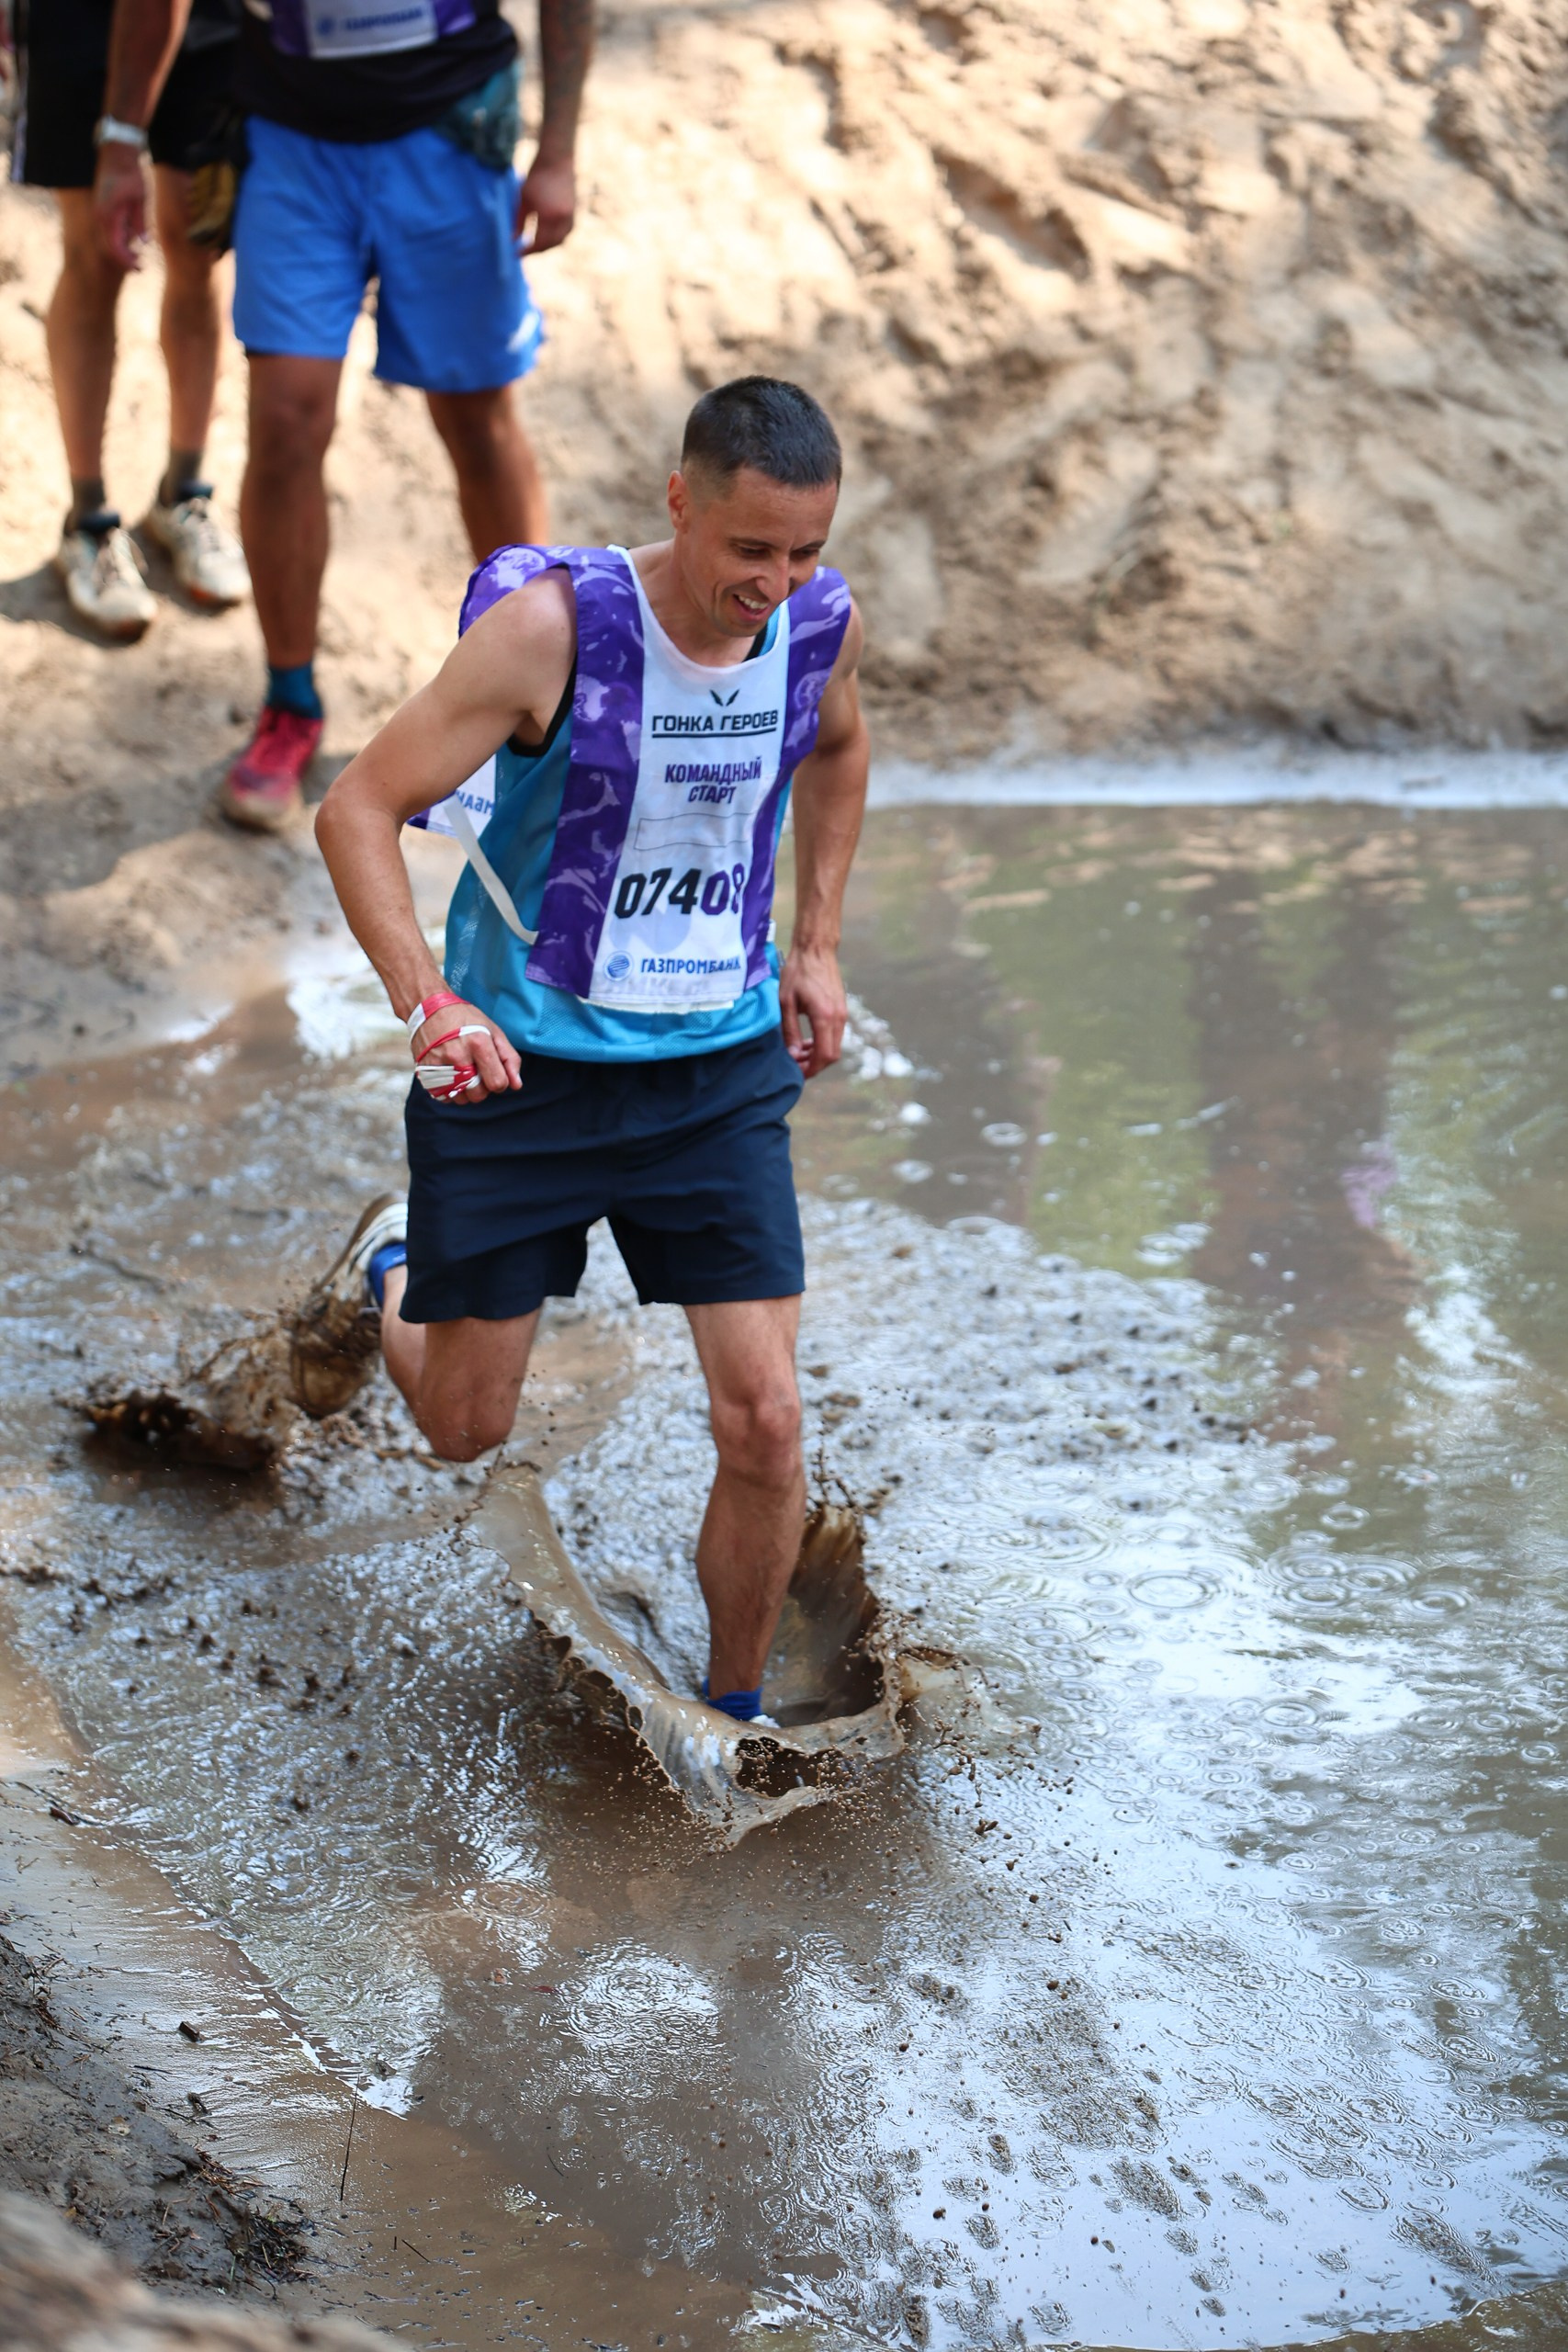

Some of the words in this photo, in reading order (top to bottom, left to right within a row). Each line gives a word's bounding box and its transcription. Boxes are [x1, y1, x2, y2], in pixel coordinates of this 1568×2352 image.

[652, 715, 714, 732] ГОНКА
[721, 709, 779, 731] ГЕРОЕВ
[665, 756, 761, 786] КОМАНДНЫЙ
[688, 785, 737, 805] СТАРТ
